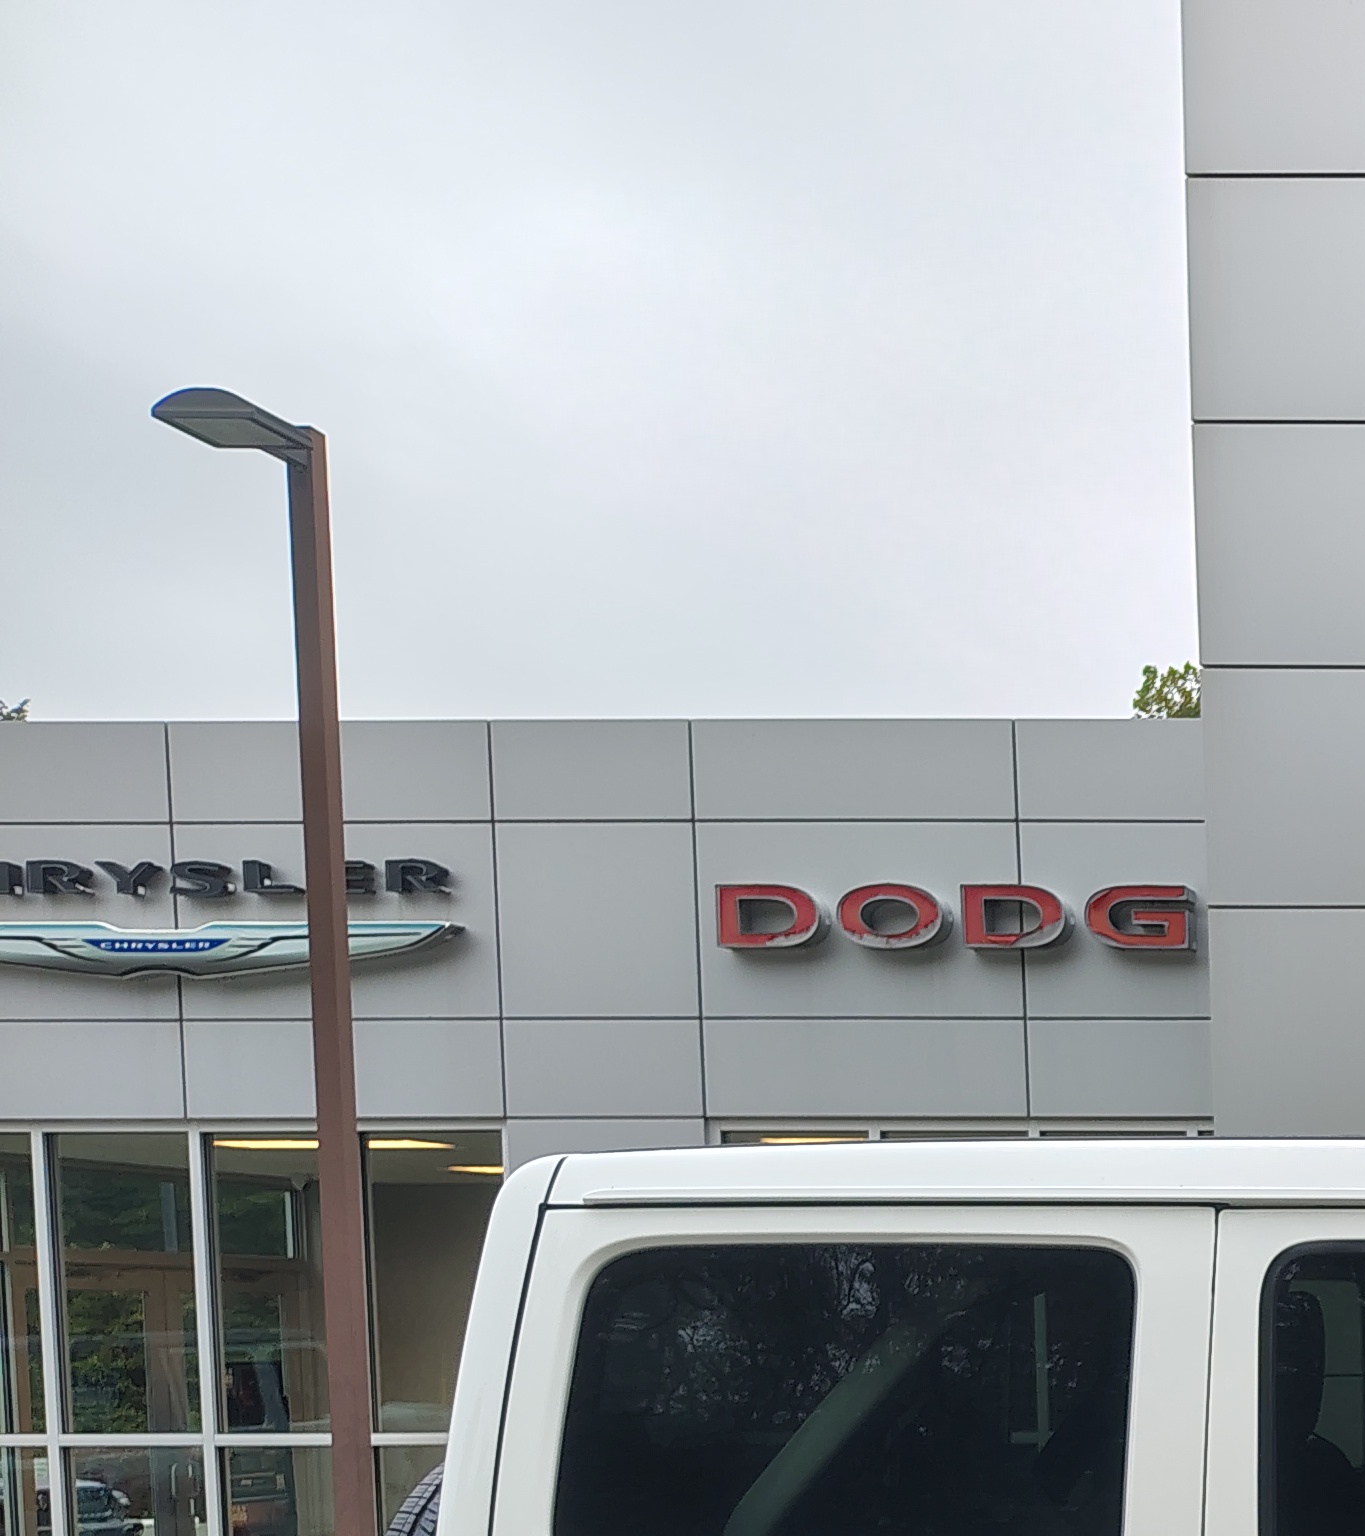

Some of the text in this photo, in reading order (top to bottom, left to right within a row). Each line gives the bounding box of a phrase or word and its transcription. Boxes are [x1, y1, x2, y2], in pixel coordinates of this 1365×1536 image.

[0, 858, 453, 896] RYSLER
[714, 882, 1197, 952] DODG
[100, 941, 210, 949] CHRYSLER
